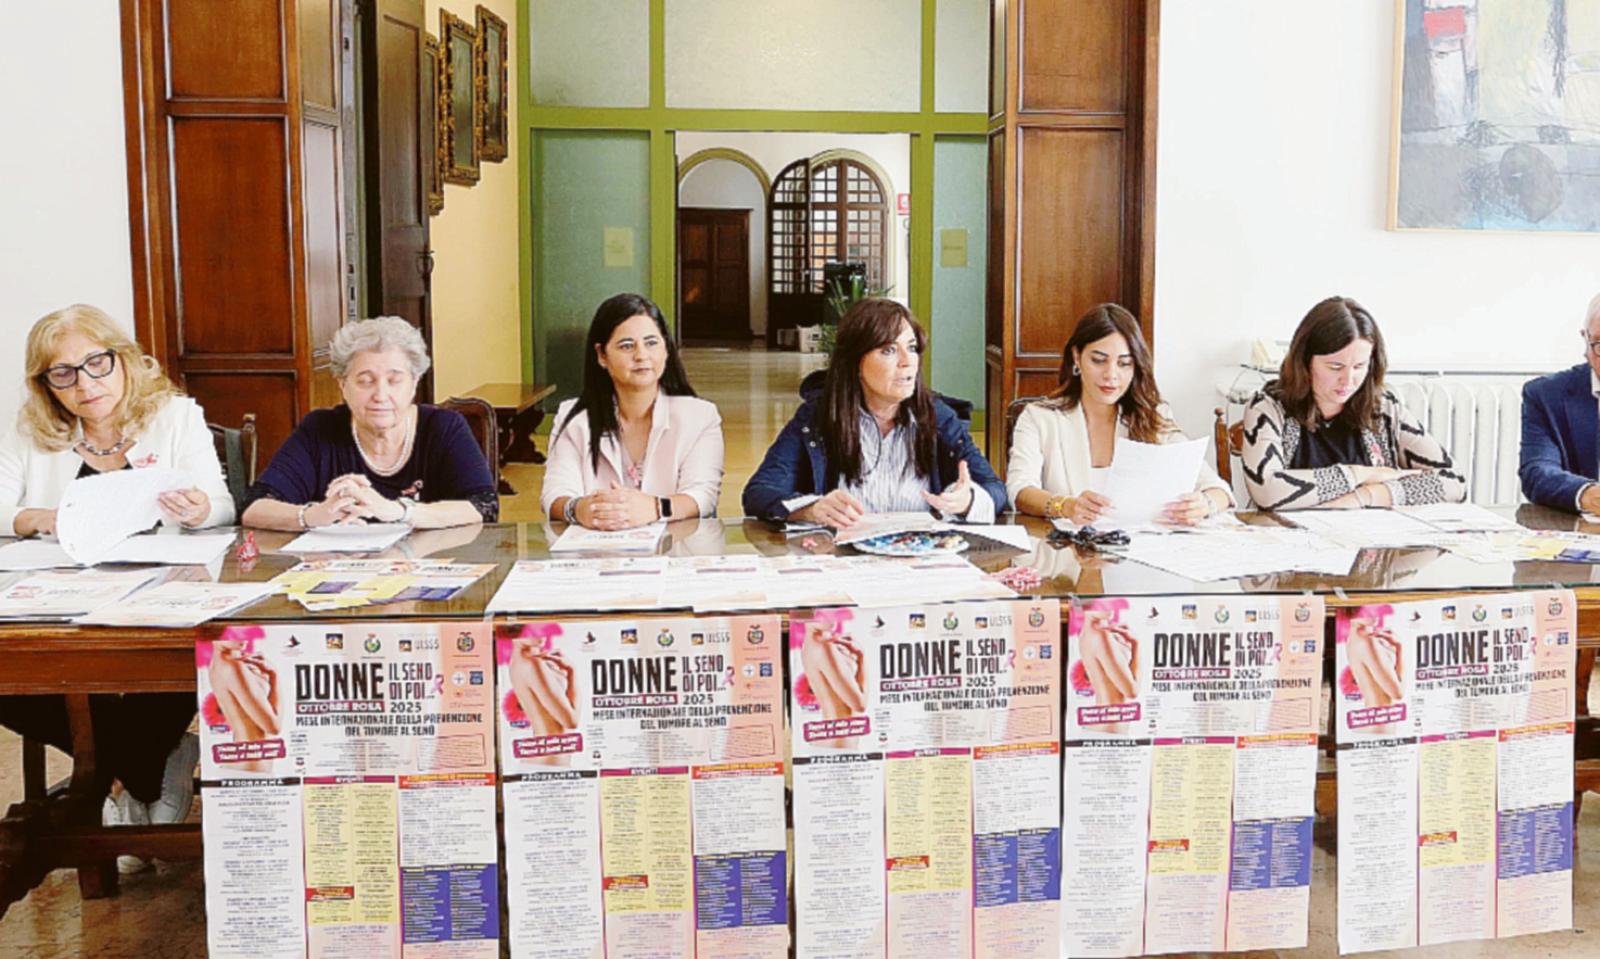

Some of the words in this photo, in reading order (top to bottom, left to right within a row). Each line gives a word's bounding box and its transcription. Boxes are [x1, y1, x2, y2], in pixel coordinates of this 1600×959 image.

[1235, 633, 1245, 649] IL
[1247, 632, 1273, 649] SENO
[1493, 630, 1502, 645] IL
[1504, 627, 1527, 644] SENO
[966, 640, 976, 656] IL
[978, 638, 1006, 656] SENO
[1154, 633, 1231, 667] DONNE
[1416, 631, 1488, 668] DONNE
[1494, 647, 1503, 662] DI
[683, 656, 691, 674] IL
[695, 655, 723, 673] SENO
[880, 640, 961, 678] DONNE
[966, 658, 977, 675] DI
[1235, 651, 1245, 667] DI
[389, 663, 399, 680] IL
[403, 662, 433, 680] SENO
[591, 657, 678, 695] DONNE
[1155, 670, 1199, 679] OTTOBRE
[1234, 669, 1261, 679] 2025
[1493, 663, 1519, 673] 2025
[295, 662, 384, 700] DONNE
[683, 675, 694, 692] DI
[882, 680, 929, 690] OTTOBRE
[931, 678, 959, 687] ROSA
[966, 677, 995, 687] 2025
[1152, 682, 1171, 691] MESE
[389, 683, 400, 699] DI
[972, 689, 996, 698] DELLA
[299, 702, 350, 712] OTTOBRE
[352, 701, 382, 712] ROSA
[390, 702, 422, 712] 2025
[595, 696, 644, 707] OTTOBRE
[646, 695, 675, 704] ROSA
[683, 694, 714, 704] 2025
[975, 700, 985, 709] AL
[986, 699, 1007, 709] SENO
[296, 716, 319, 726] MESE
[320, 714, 393, 726] INTERNAZIONALE
[395, 714, 421, 724] DELLA
[424, 713, 482, 723] PREVENZIONE
[593, 710, 615, 720] MESE
[616, 707, 686, 719] INTERNAZIONALE
[688, 707, 713, 717] DELLA
[715, 704, 772, 715] PREVENZIONE
[345, 727, 361, 736] DEL
[363, 727, 399, 736] TUMORE
[401, 726, 410, 735] AL
[412, 725, 435, 735] SENO
[641, 720, 656, 729] DEL
[658, 719, 692, 729] TUMORE
[693, 719, 702, 727] AL
[704, 717, 726, 727] SENO
